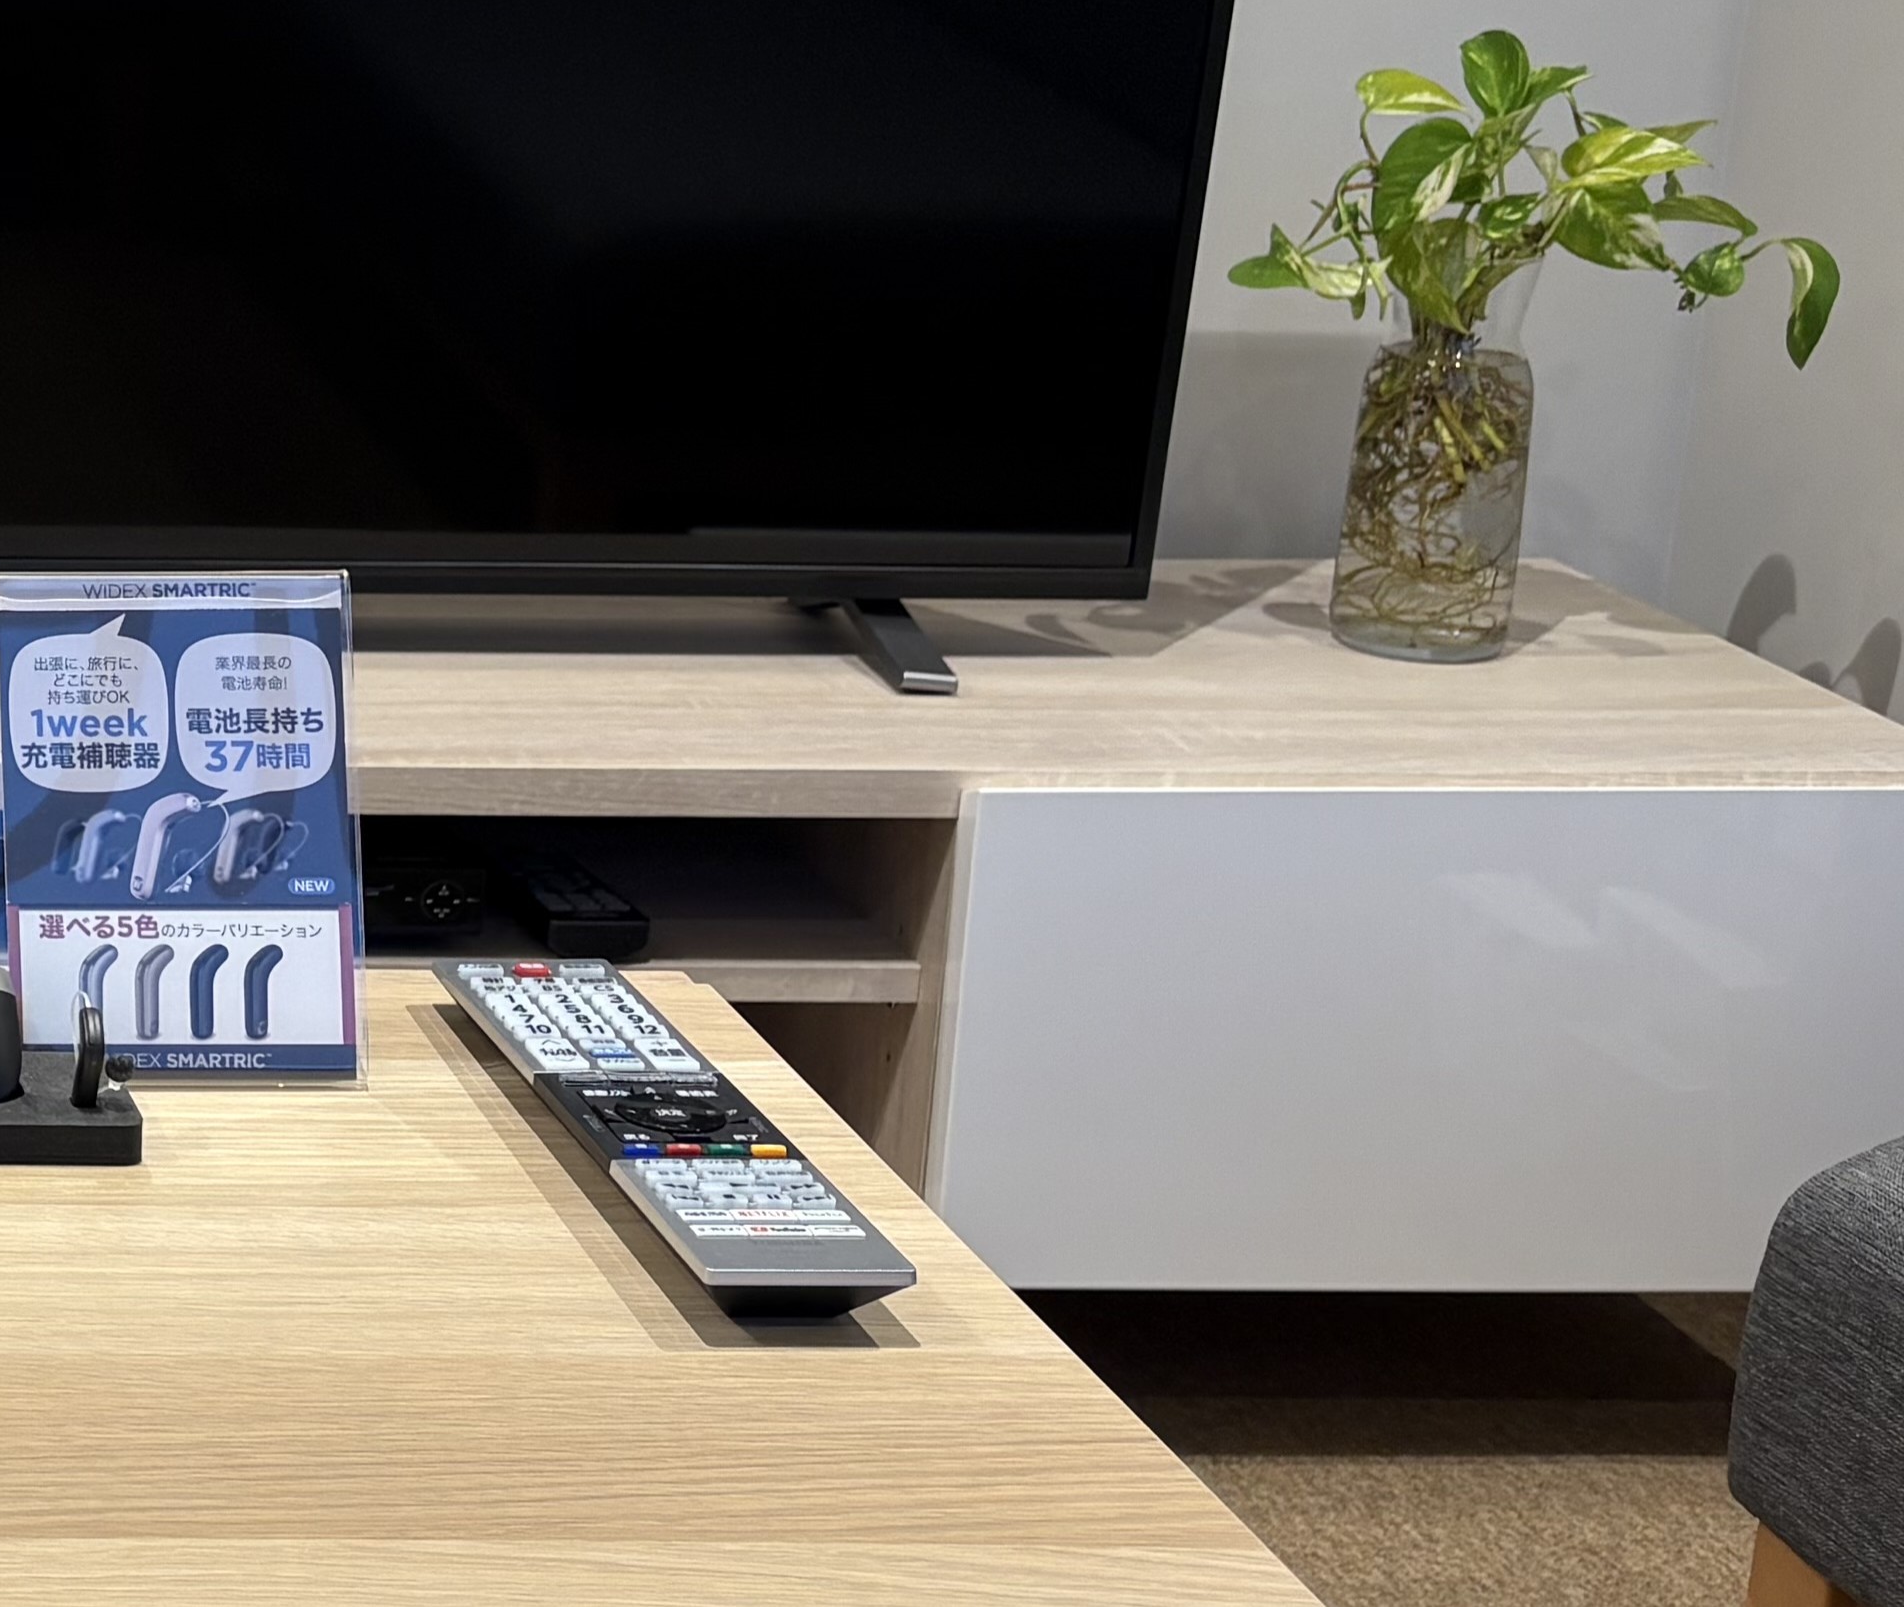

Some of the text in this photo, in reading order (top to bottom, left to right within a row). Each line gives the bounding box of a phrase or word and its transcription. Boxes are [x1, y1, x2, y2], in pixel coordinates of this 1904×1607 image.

[82, 583, 148, 598] WIDEX
[33, 655, 139, 671] 出張に、旅行に、
[214, 655, 292, 670] 業界最長の
[53, 673, 123, 687] どこにでも
[47, 689, 131, 705] 持ち運びOK
[30, 707, 149, 737] 1week
[185, 707, 325, 734] 電池長持ち
[20, 741, 161, 769] 充電補聴器
[204, 740, 311, 773] 37時間
[293, 880, 330, 892] NEW
[38, 914, 323, 939] 選べる5色のカラーバリエーション
[504, 994, 517, 1004] 1
[555, 994, 571, 1004] 2
[609, 994, 625, 1004] 3
[512, 1004, 529, 1014] 4
[564, 1004, 582, 1014] 5
[617, 1004, 635, 1014] 6
[519, 1014, 536, 1024] 7
[575, 1014, 592, 1024] 8
[627, 1014, 645, 1025] 9
[525, 1024, 552, 1035] 10
[581, 1024, 606, 1035] 11
[634, 1024, 662, 1035] 12
